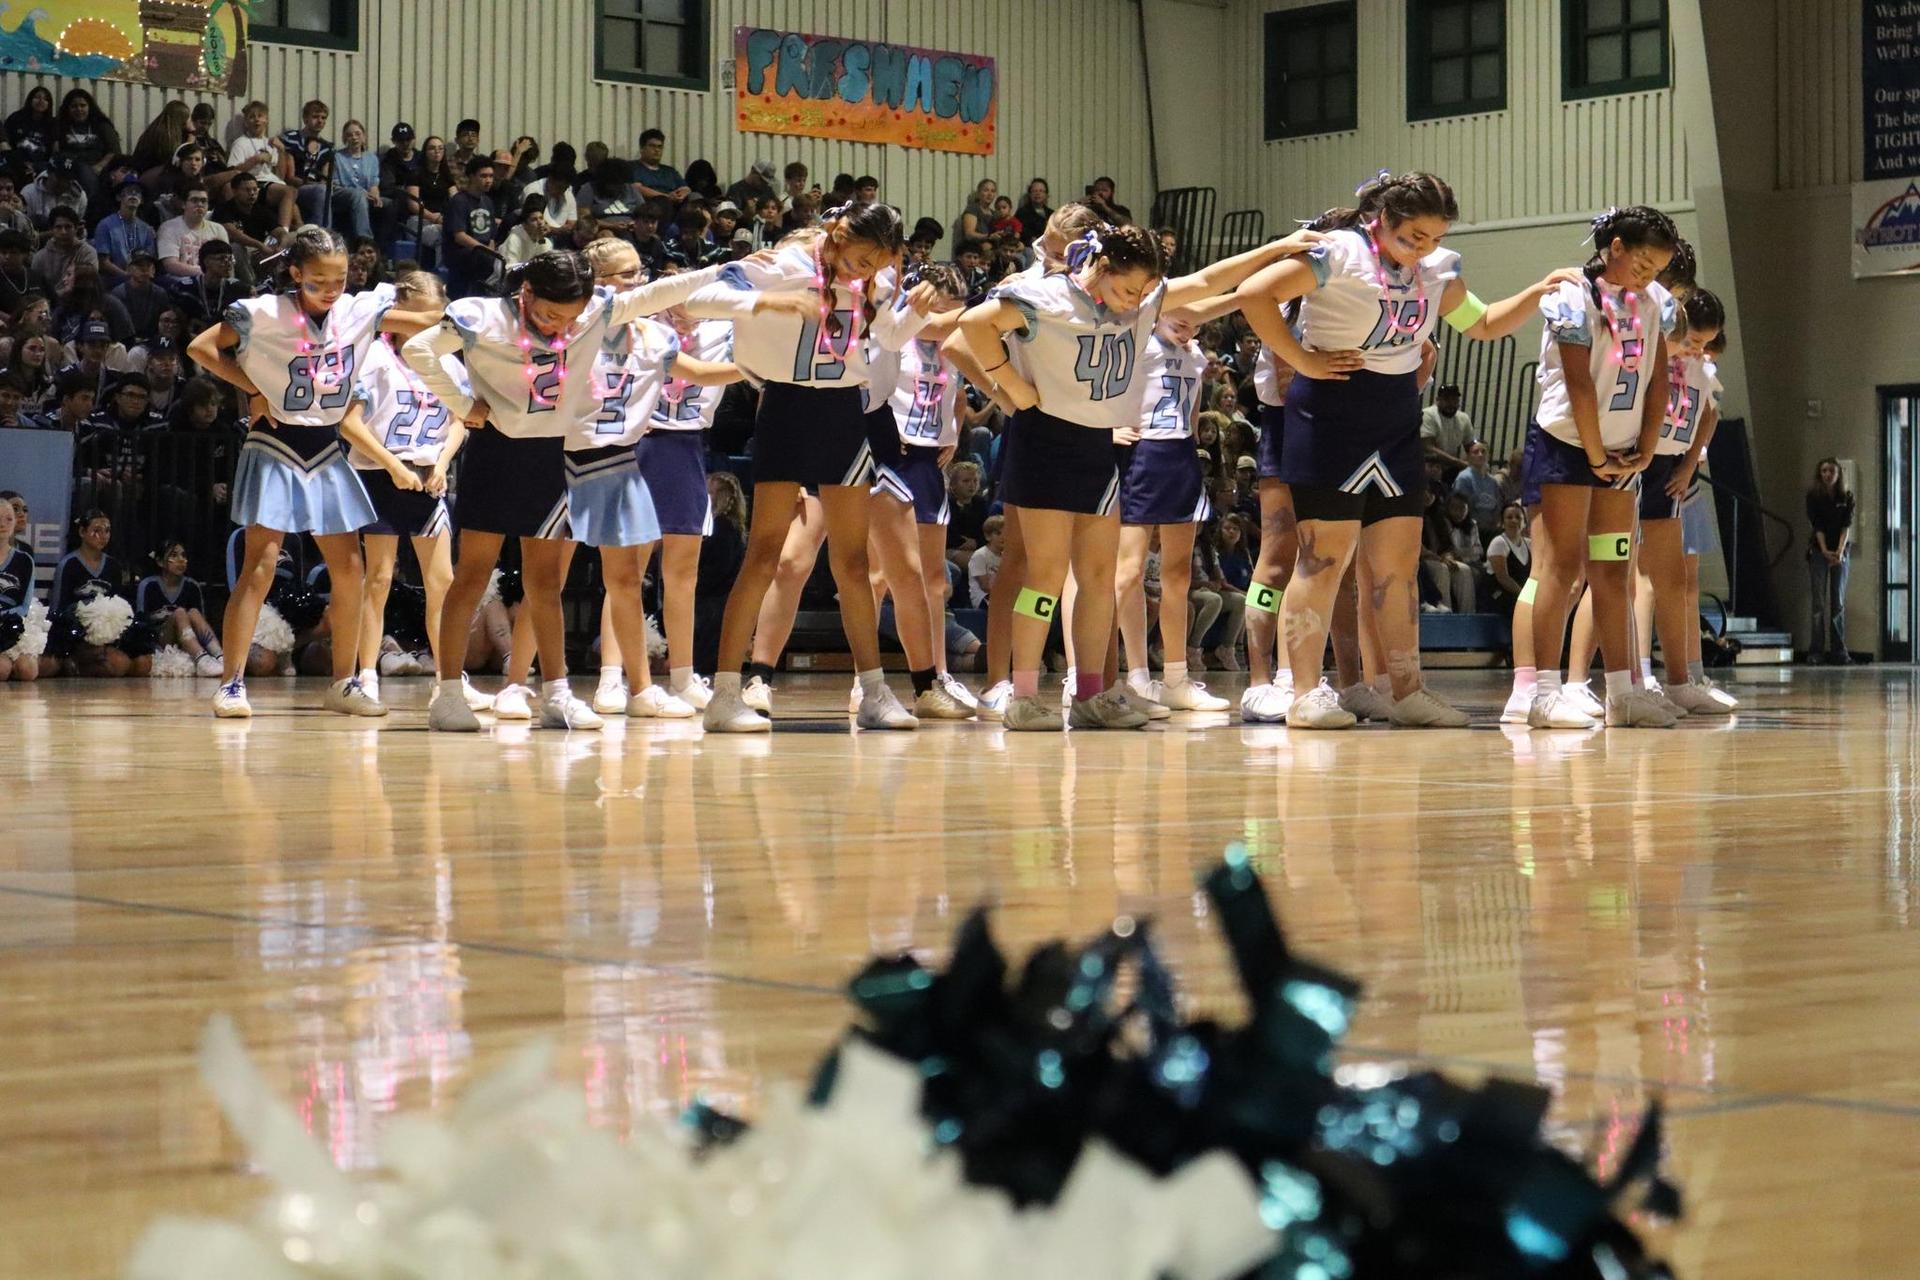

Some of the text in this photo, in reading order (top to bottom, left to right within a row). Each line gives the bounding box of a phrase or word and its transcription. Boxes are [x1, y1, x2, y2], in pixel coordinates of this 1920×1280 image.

[1875, 4, 1897, 18] We
[1876, 23, 1913, 41] Bring
[1876, 43, 1911, 60] We'll
[746, 28, 992, 124] FRESHMEN
[1875, 88, 1901, 103] Our
[1875, 113, 1900, 128] The
[1875, 153, 1903, 170] And
[1074, 328, 1135, 401] 40
[527, 349, 567, 414] 2
[1608, 338, 1644, 412] 5
[595, 373, 636, 434] 3
[1149, 375, 1197, 431] 21
[384, 390, 449, 448] 22
[1616, 537, 1628, 557] C
[1034, 596, 1053, 617] C
[1257, 588, 1273, 608] C
